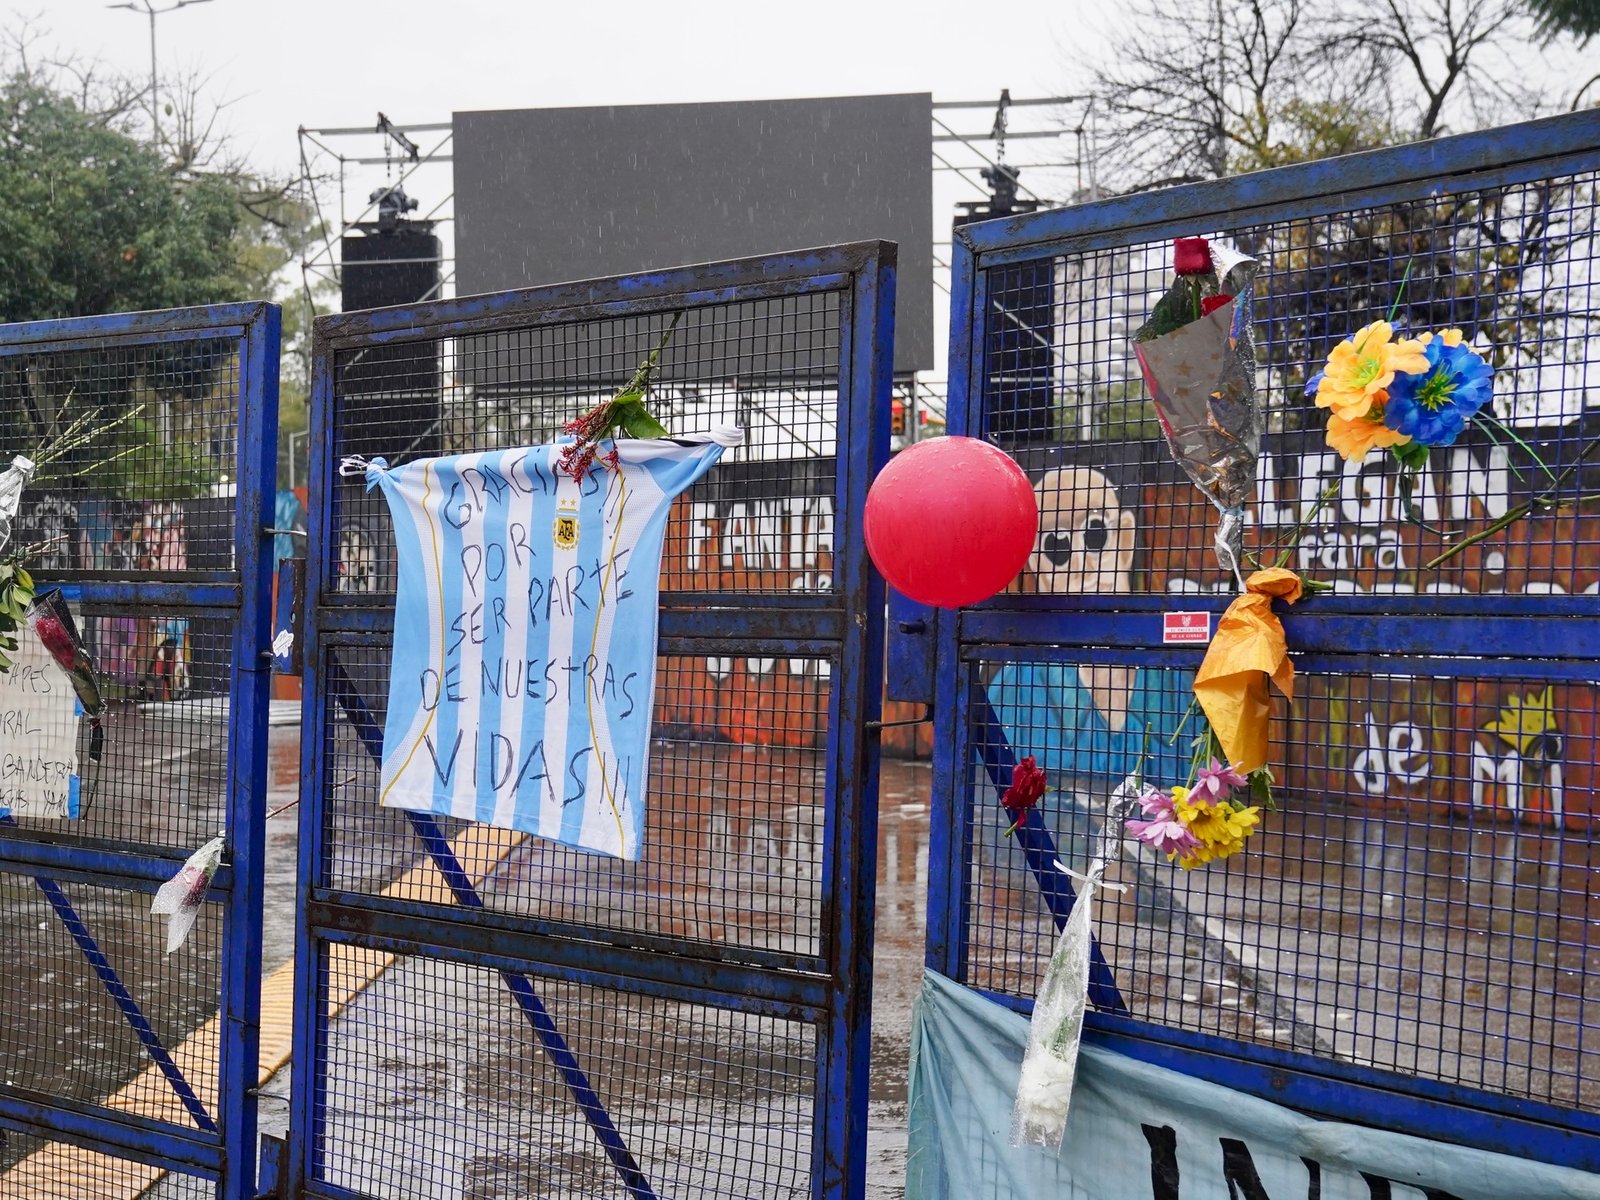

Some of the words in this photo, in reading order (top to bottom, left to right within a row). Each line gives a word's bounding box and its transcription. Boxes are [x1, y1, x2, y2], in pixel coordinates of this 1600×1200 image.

[461, 523, 536, 598] POR
[1300, 530, 1406, 570] para
[447, 597, 512, 656] SER
[528, 549, 634, 627] PARTE
[420, 664, 468, 711] DE
[481, 654, 637, 720] NUESTRAS
[1353, 711, 1432, 794] de
